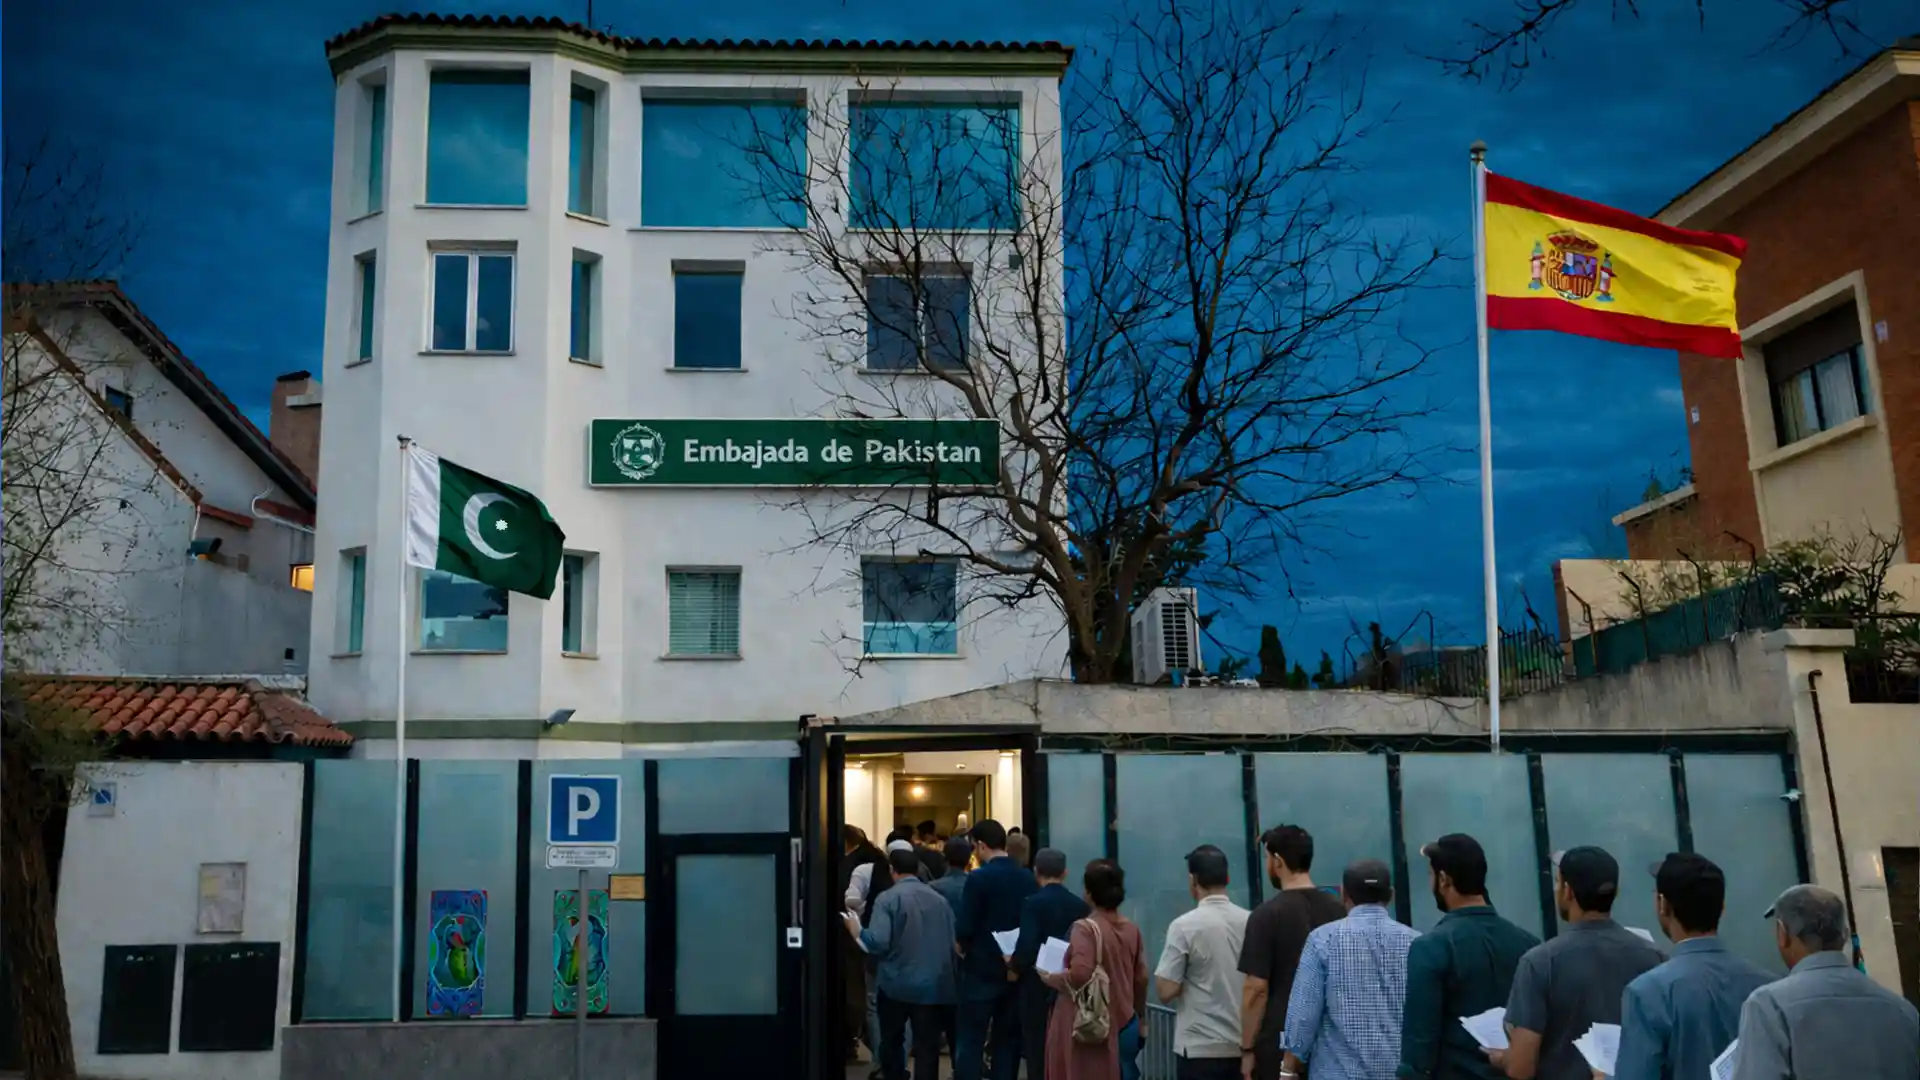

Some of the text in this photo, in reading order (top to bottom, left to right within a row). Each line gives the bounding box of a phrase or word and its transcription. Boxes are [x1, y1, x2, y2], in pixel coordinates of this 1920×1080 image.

[684, 438, 981, 468] Embajada de Pakistan
[568, 786, 601, 836] P
